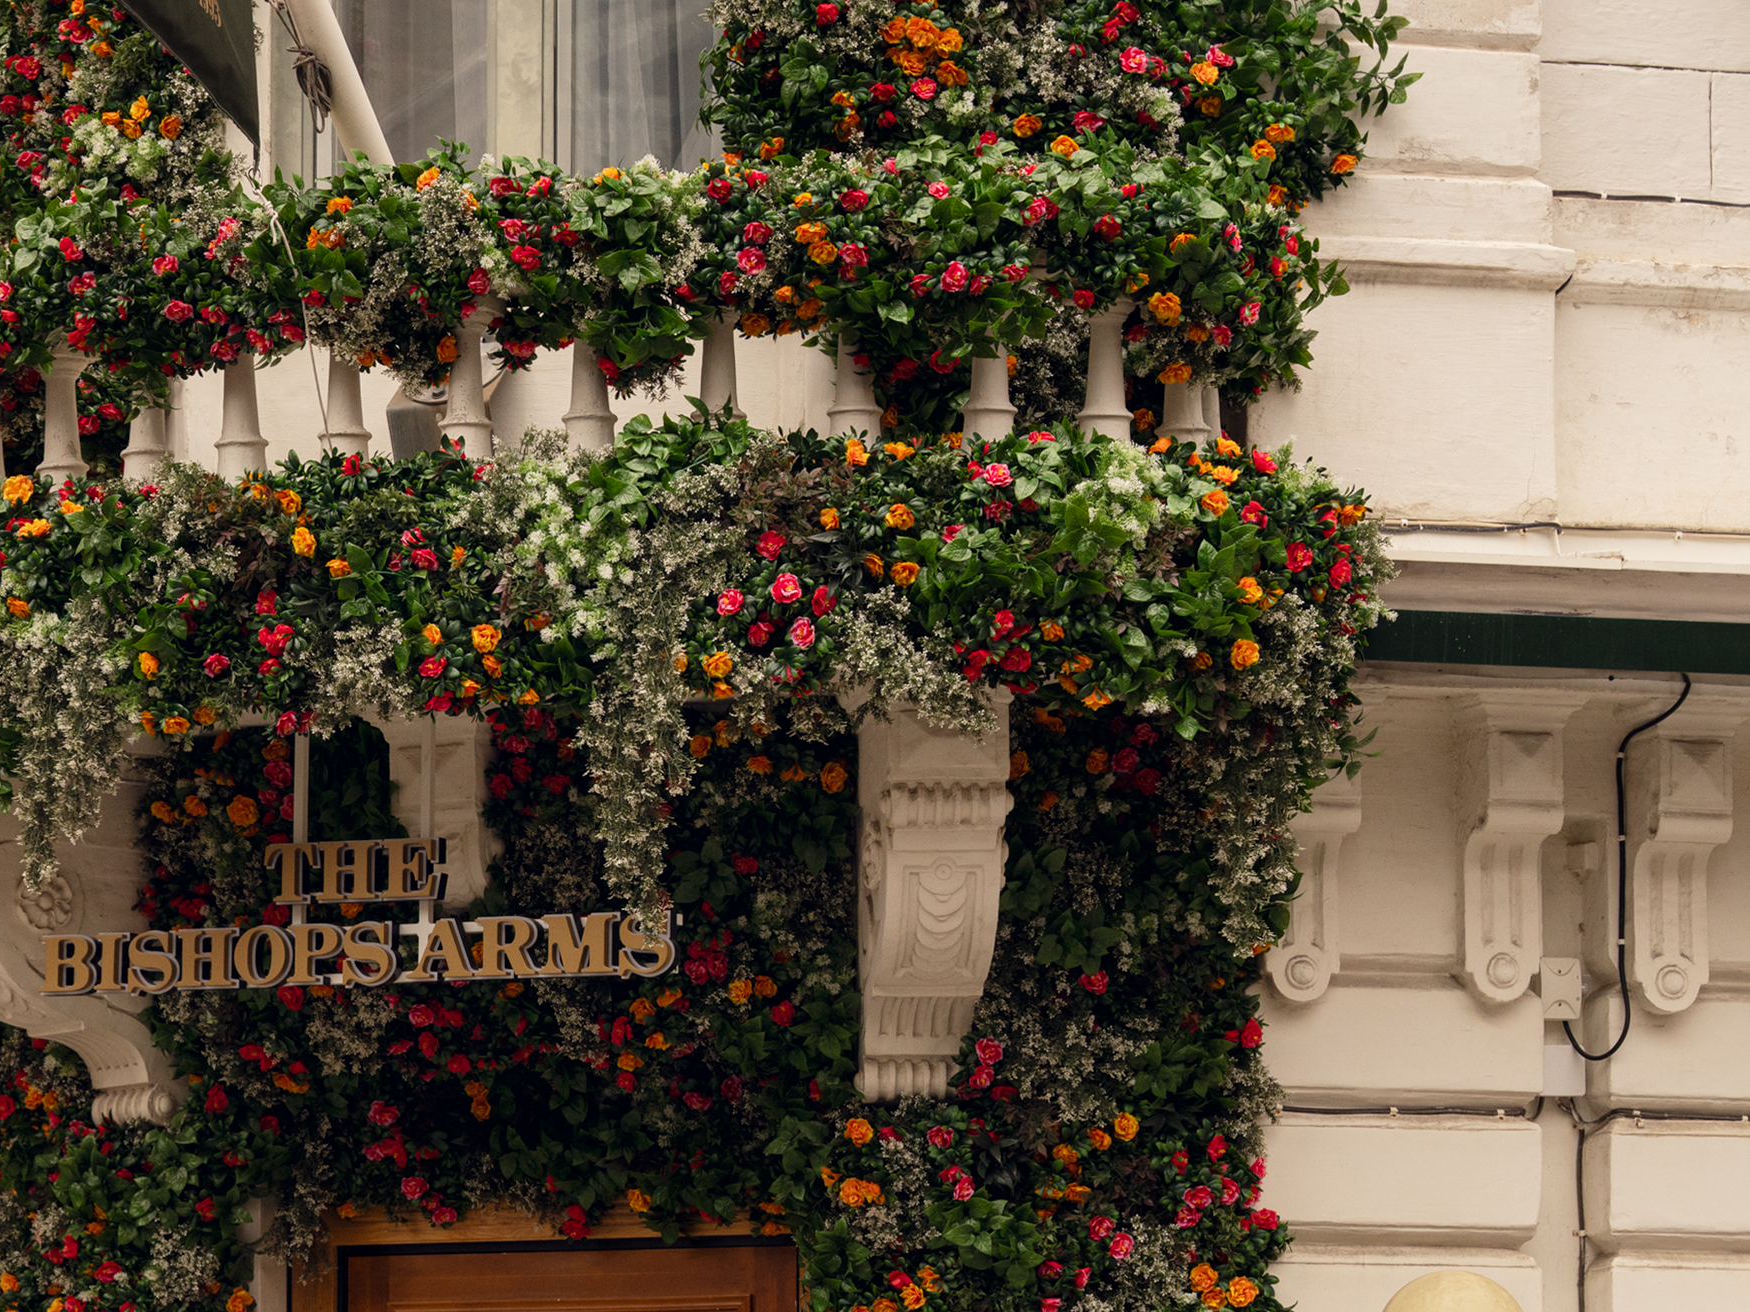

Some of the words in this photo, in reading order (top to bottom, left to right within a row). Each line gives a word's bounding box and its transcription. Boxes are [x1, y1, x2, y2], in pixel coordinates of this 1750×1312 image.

[263, 838, 447, 903] THE
[39, 921, 398, 998] BISHOPS
[406, 911, 676, 981] ARMS
